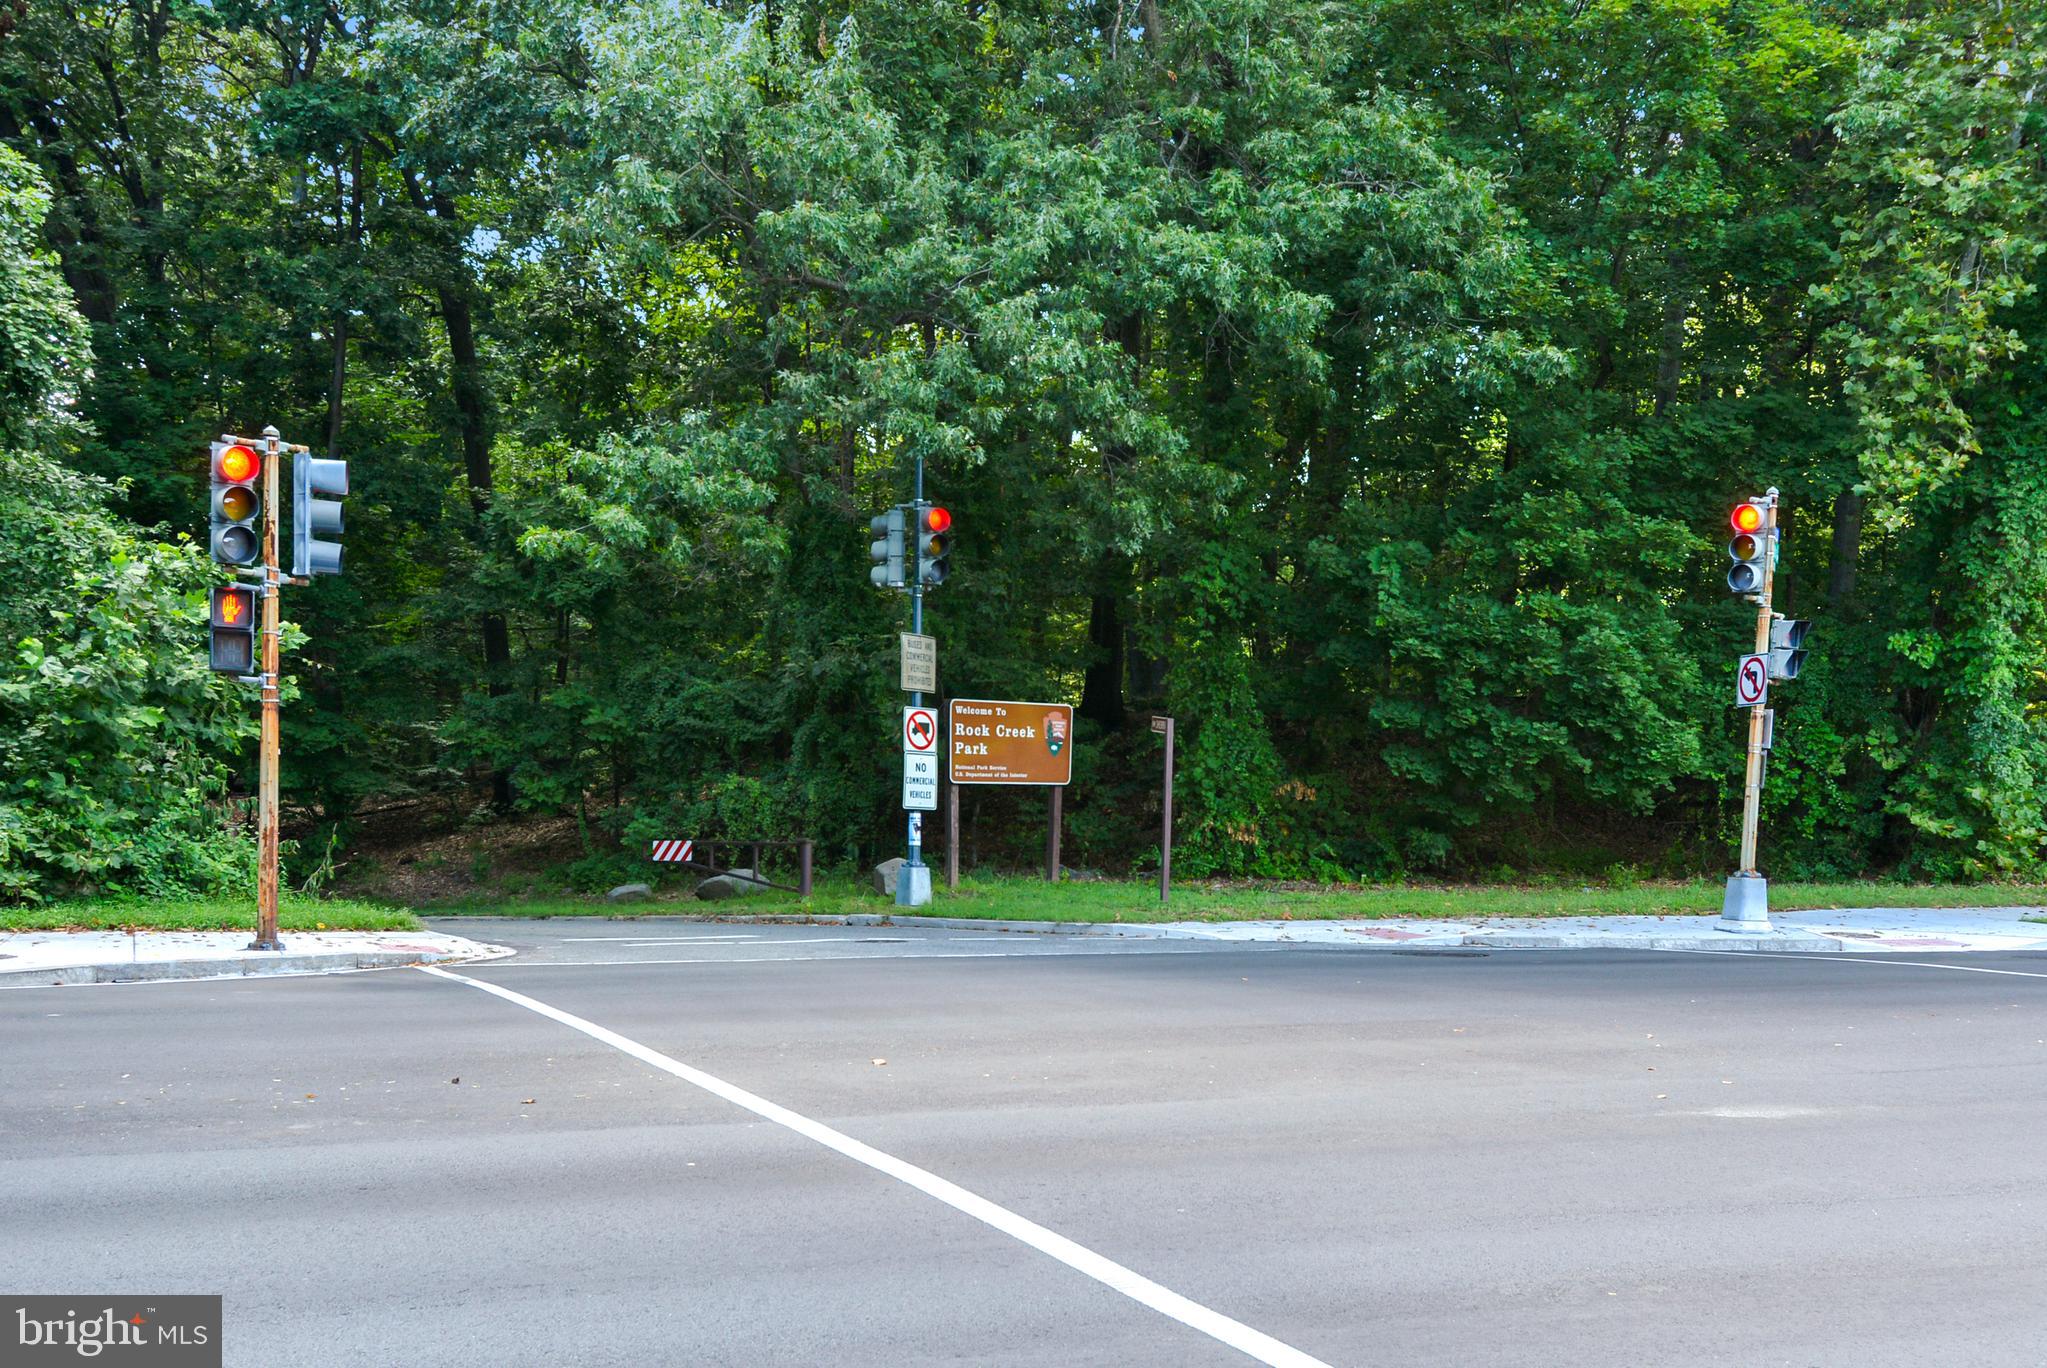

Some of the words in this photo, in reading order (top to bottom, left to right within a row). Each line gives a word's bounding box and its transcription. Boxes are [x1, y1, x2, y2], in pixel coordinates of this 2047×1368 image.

[906, 651, 934, 663] COMMERCIAL
[955, 705, 993, 715] Welcome
[995, 707, 1007, 716] To
[955, 723, 991, 737] Rock
[996, 724, 1036, 738] Creek
[955, 742, 988, 755] Park
[915, 762, 927, 773] NO
[906, 777, 936, 786] COMMERCIAL
[910, 791, 932, 799] VEHICLES
